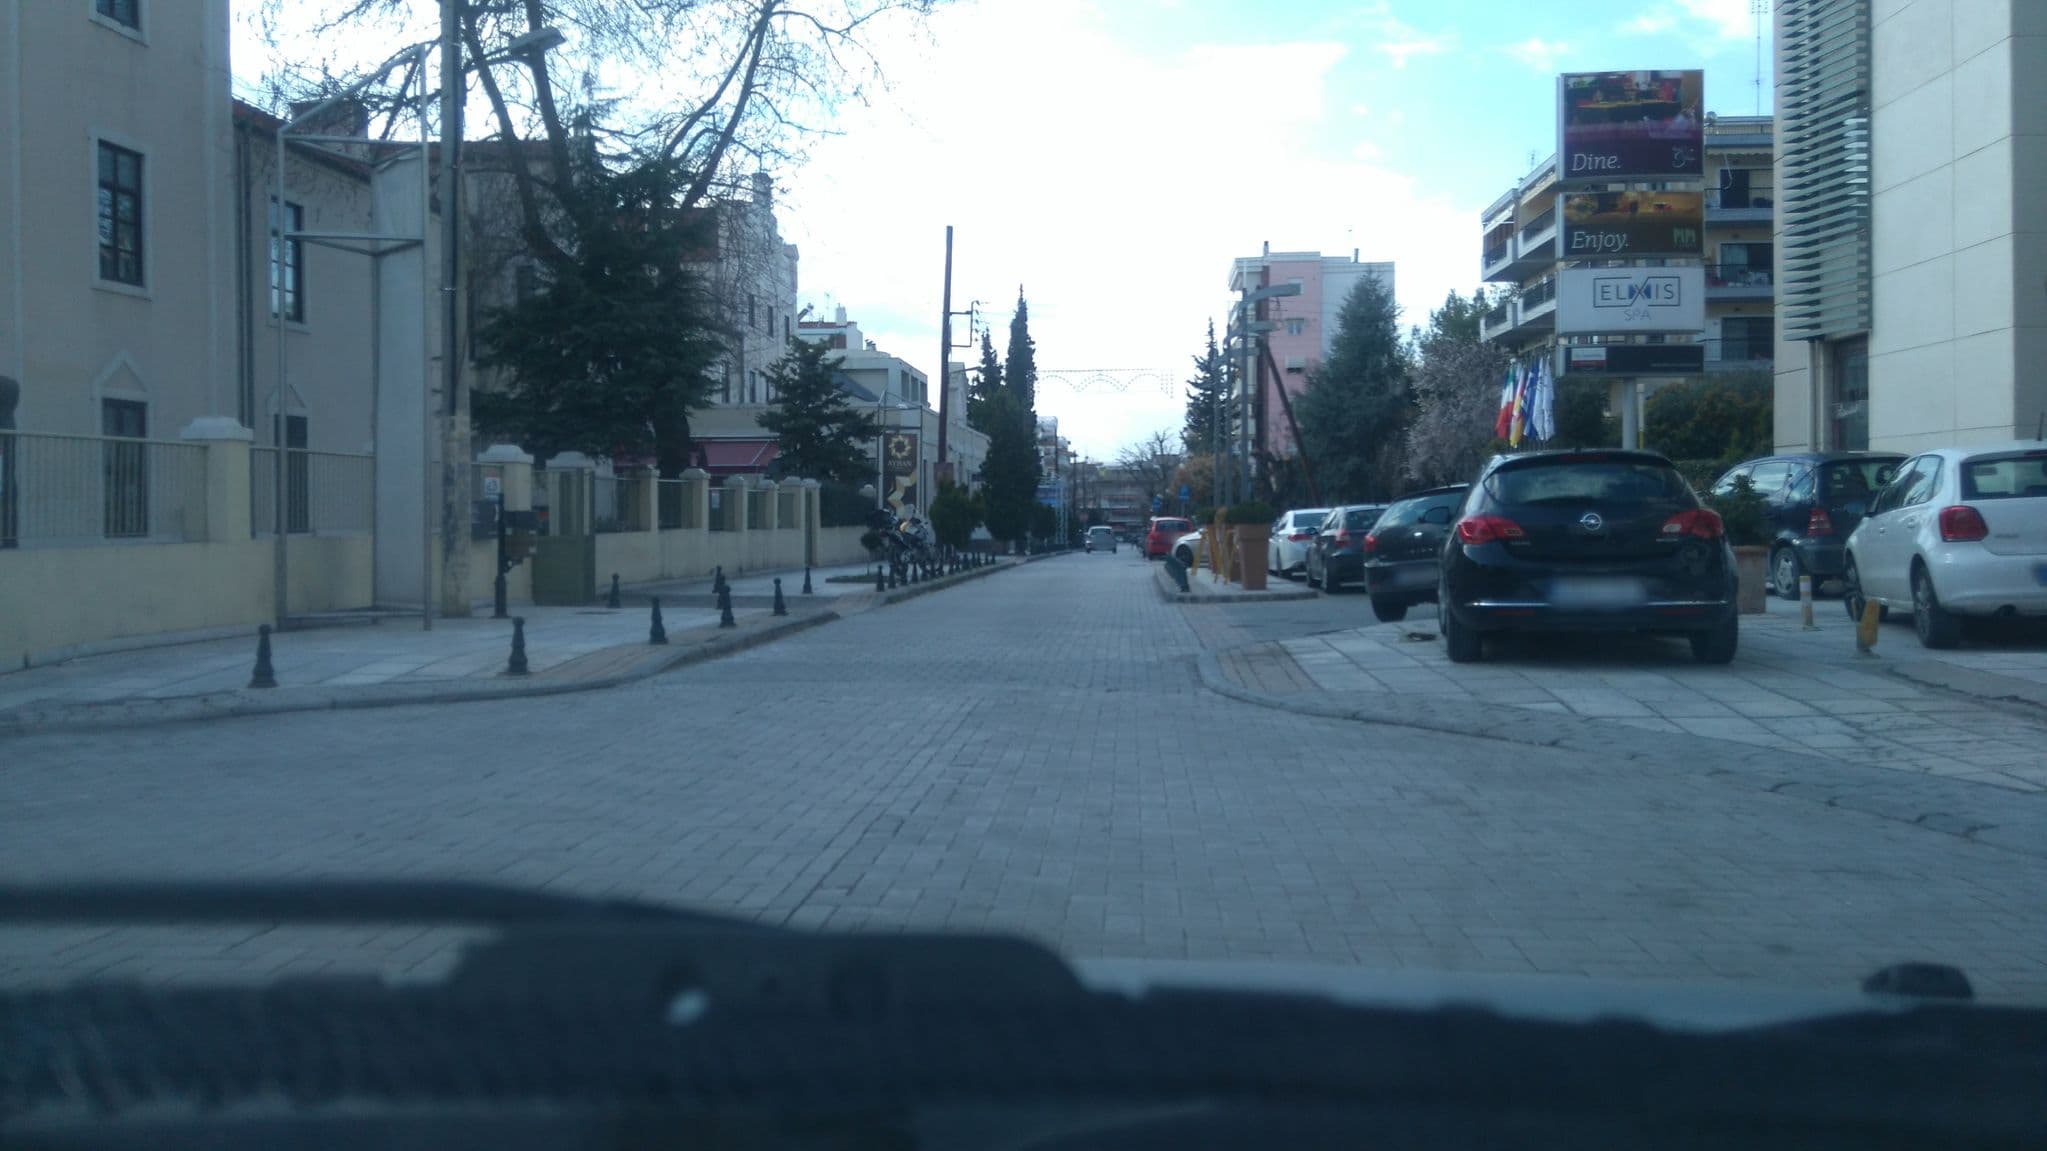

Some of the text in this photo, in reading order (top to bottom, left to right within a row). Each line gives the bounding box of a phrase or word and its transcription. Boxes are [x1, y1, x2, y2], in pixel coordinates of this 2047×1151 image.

[1572, 154, 1621, 171] Dine.
[1571, 231, 1629, 251] Enjoy.
[1601, 284, 1674, 300] ELXIS
[1624, 310, 1651, 321] SPA
